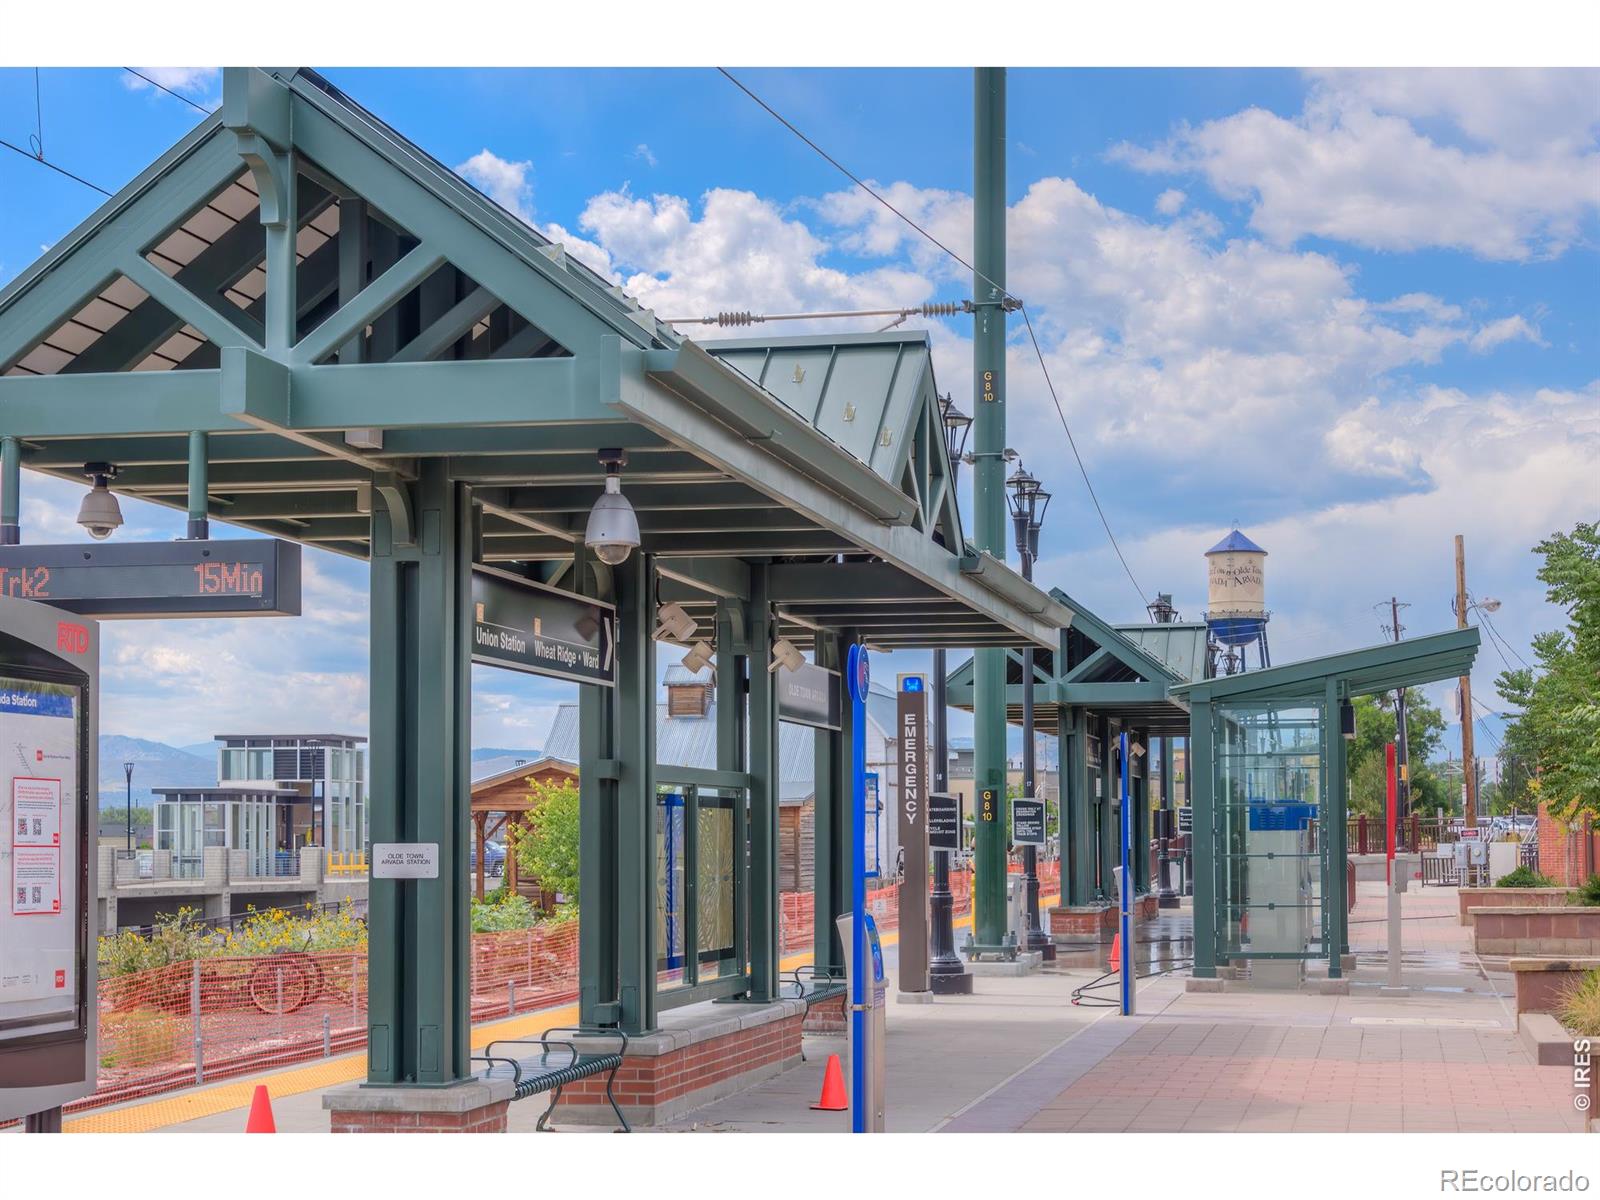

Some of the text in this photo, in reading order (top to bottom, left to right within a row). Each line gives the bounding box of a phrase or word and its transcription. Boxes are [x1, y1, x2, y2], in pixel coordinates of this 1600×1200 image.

[983, 371, 992, 381] G
[984, 382, 992, 391] 8
[983, 392, 994, 402] 10
[194, 562, 263, 593] 15Min
[57, 621, 89, 654] RTD
[475, 626, 526, 654] Union Station
[534, 640, 600, 670] Wheat Ridge Ward
[11, 694, 37, 707] Station
[904, 713, 918, 825] EMERGENCY
[983, 791, 992, 800] G
[984, 801, 991, 811] 8
[982, 812, 993, 821] 10
